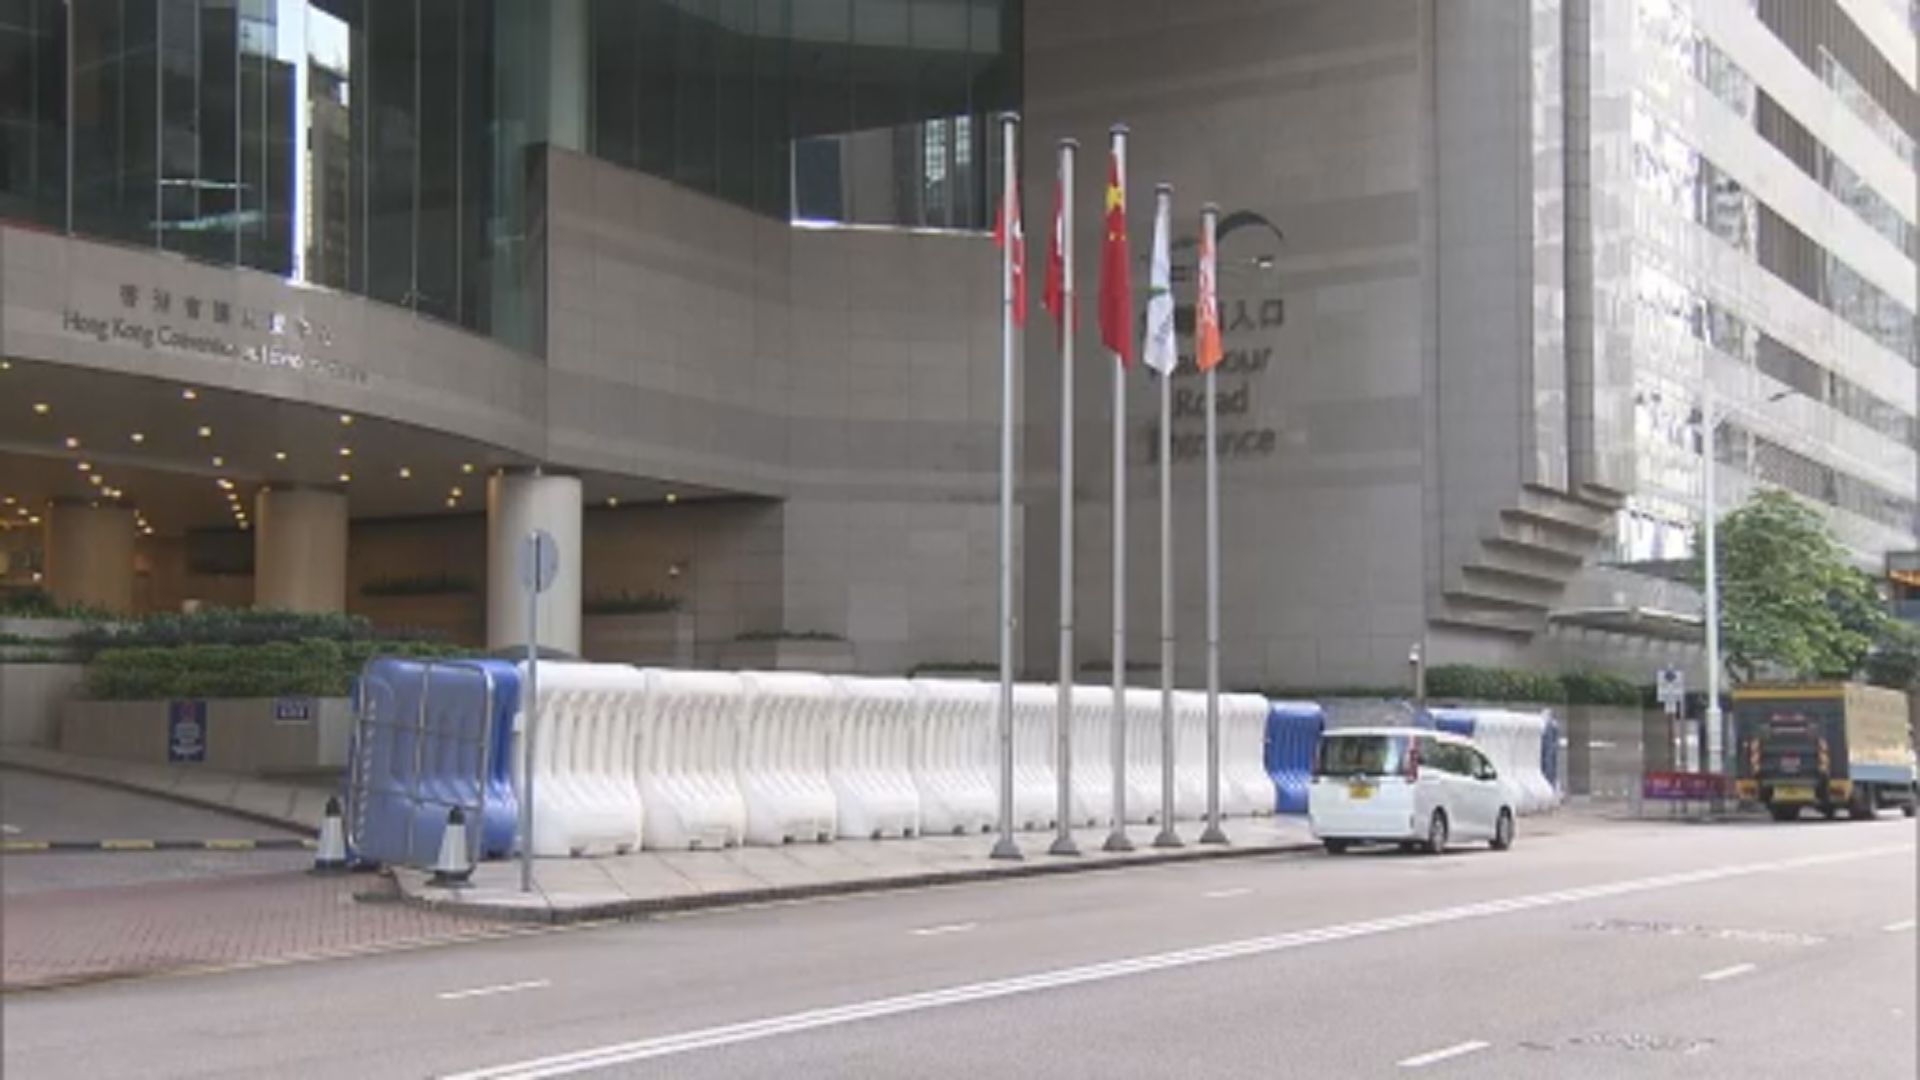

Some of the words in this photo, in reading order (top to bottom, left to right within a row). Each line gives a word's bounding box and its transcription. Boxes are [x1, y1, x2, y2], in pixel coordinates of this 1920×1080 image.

[61, 309, 109, 343] Hong
[111, 317, 155, 350] Kong
[1174, 382, 1249, 418] Road
